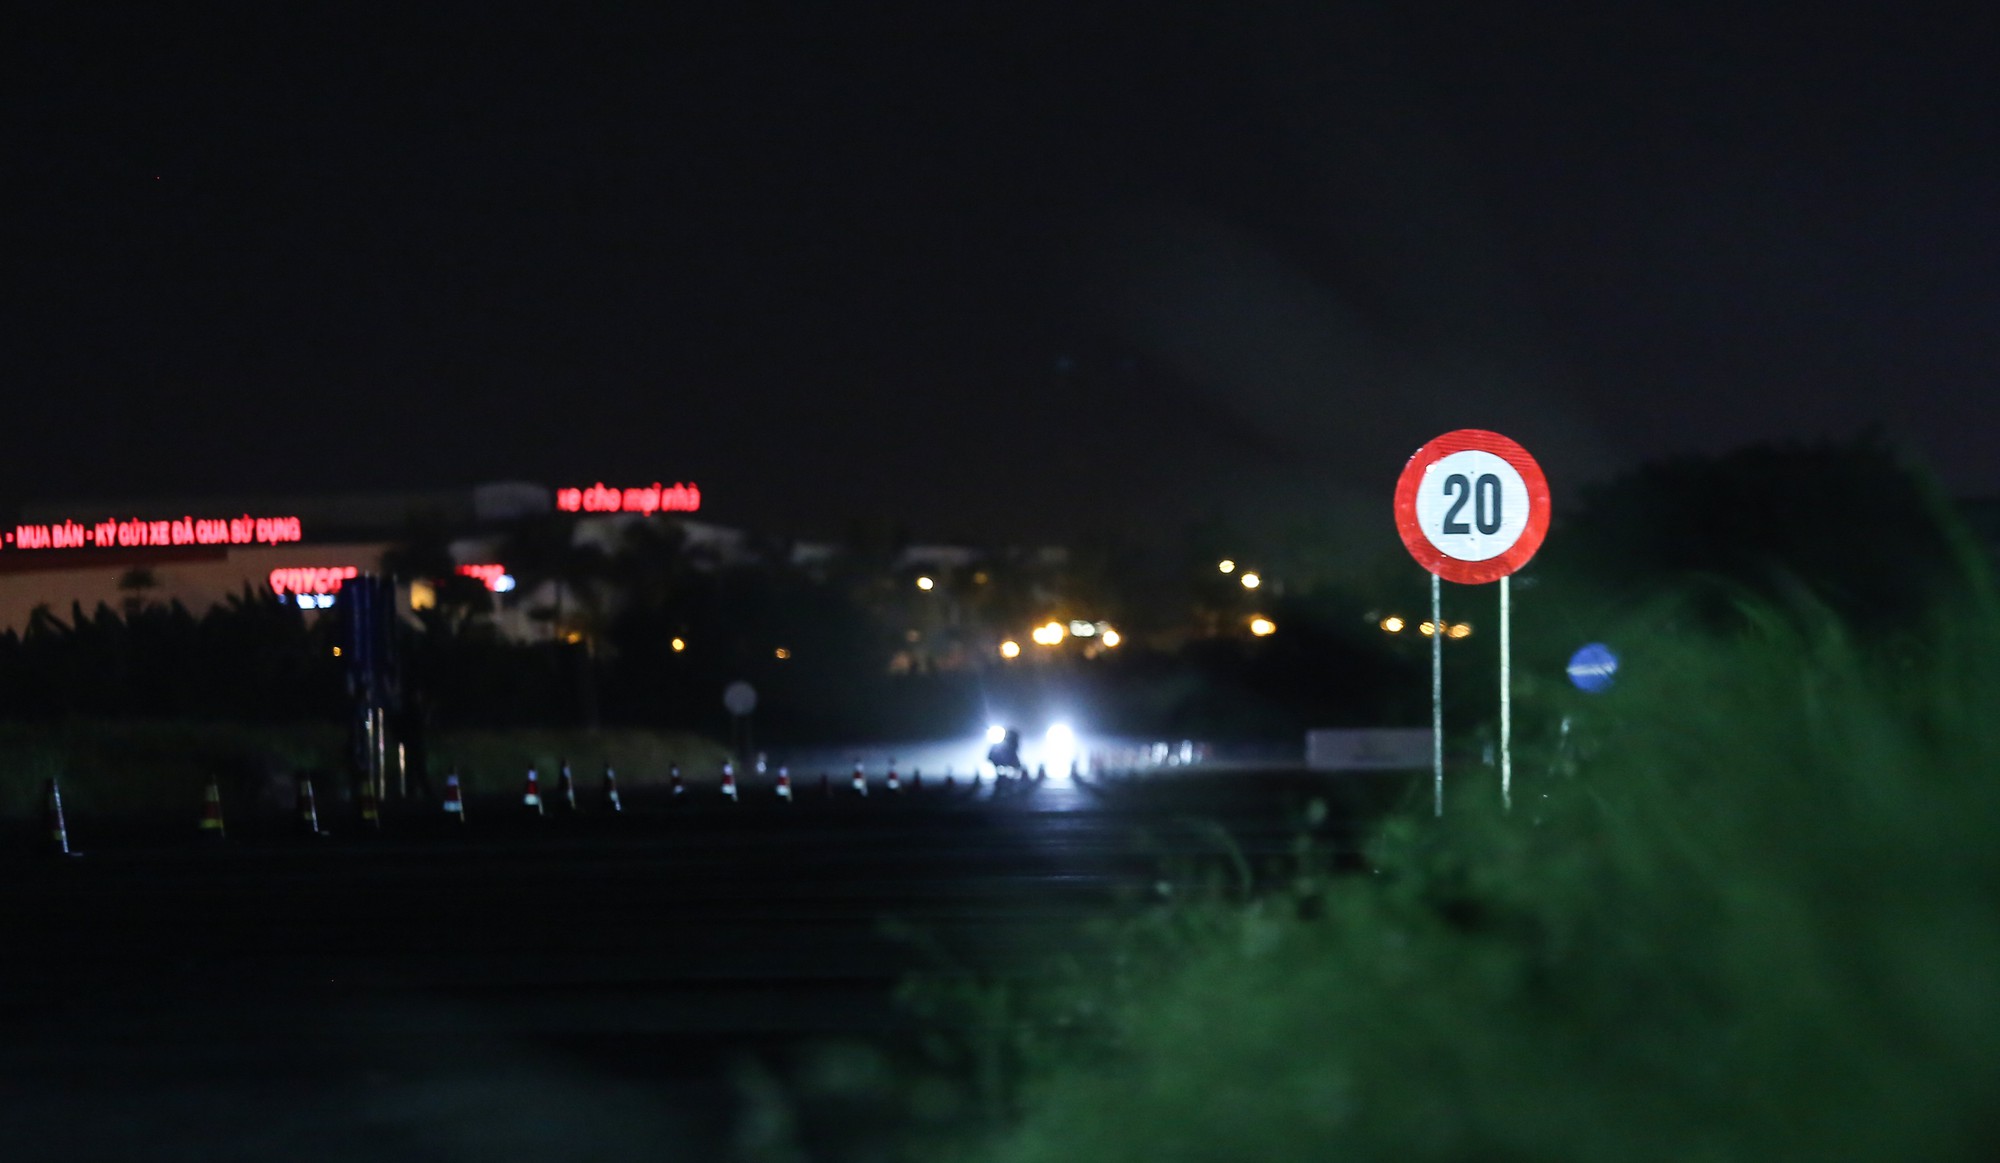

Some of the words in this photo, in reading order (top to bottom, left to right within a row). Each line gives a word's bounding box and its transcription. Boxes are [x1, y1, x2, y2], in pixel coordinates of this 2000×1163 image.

[582, 482, 621, 512] cho
[1443, 473, 1502, 535] 20
[17, 525, 51, 549] MUA
[52, 519, 84, 548] BÁN
[95, 517, 116, 547] KÝ
[149, 521, 170, 546] XE
[195, 519, 229, 544] QUA
[256, 516, 301, 546] DỤNG
